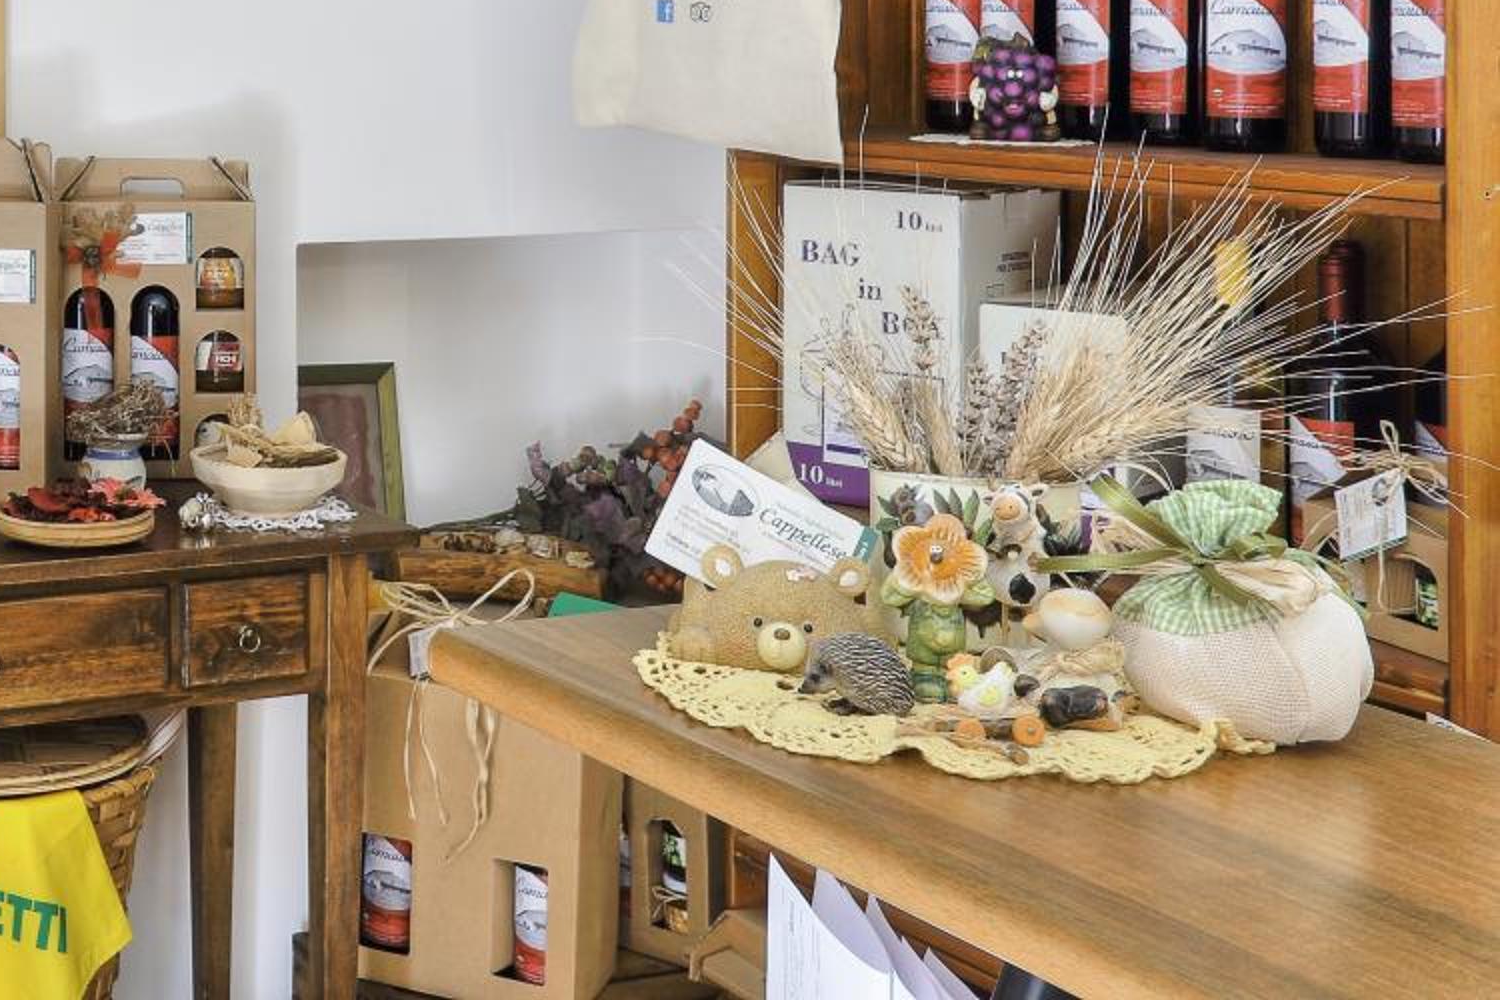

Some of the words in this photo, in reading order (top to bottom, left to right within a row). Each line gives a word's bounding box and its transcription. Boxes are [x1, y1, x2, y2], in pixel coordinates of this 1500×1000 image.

[896, 210, 922, 231] 10
[802, 239, 860, 266] BAG
[858, 277, 882, 301] in
[798, 463, 823, 485] 10
[758, 505, 848, 561] Cappellese
